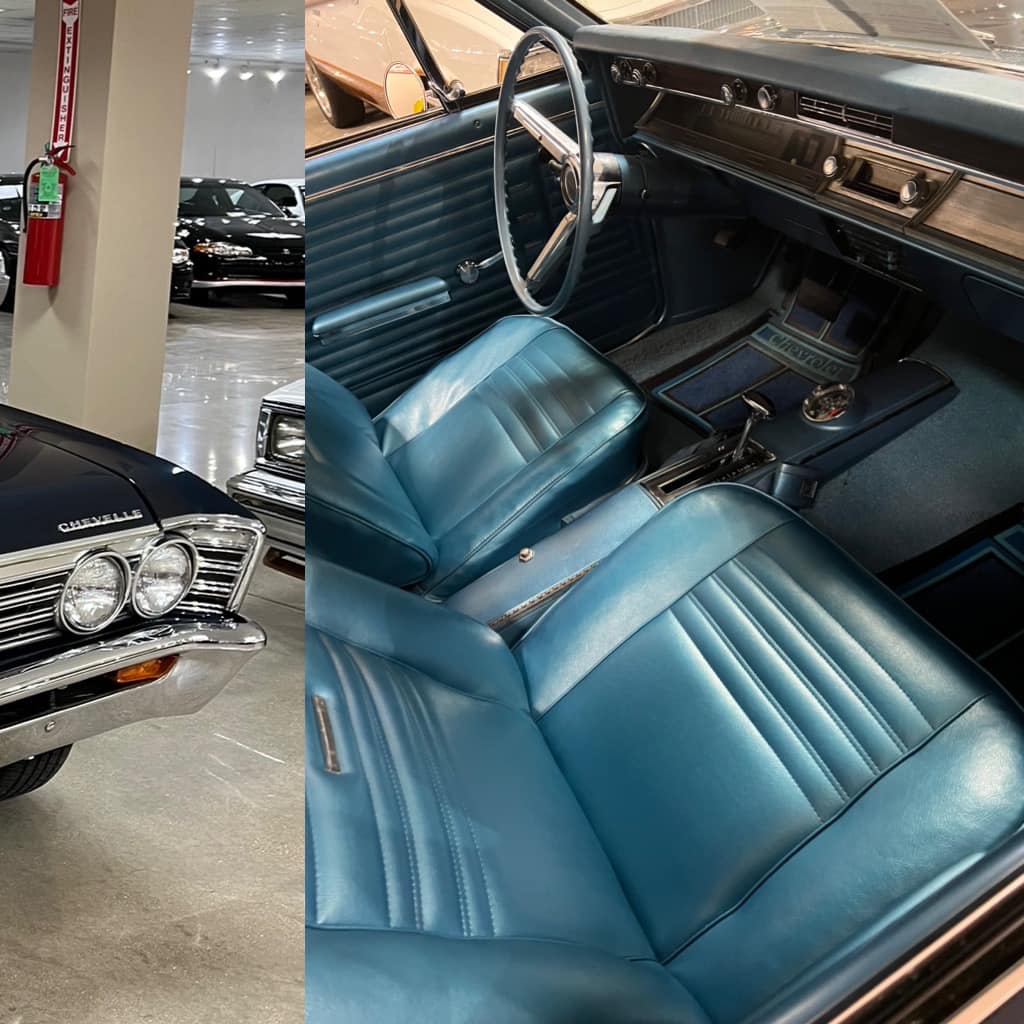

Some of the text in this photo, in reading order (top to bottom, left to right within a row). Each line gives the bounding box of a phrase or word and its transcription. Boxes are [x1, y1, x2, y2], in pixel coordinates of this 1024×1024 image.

[63, 8, 78, 16] FIRE
[59, 26, 73, 140] EXTINGUISHER
[58, 508, 144, 533] CHEVELLE
